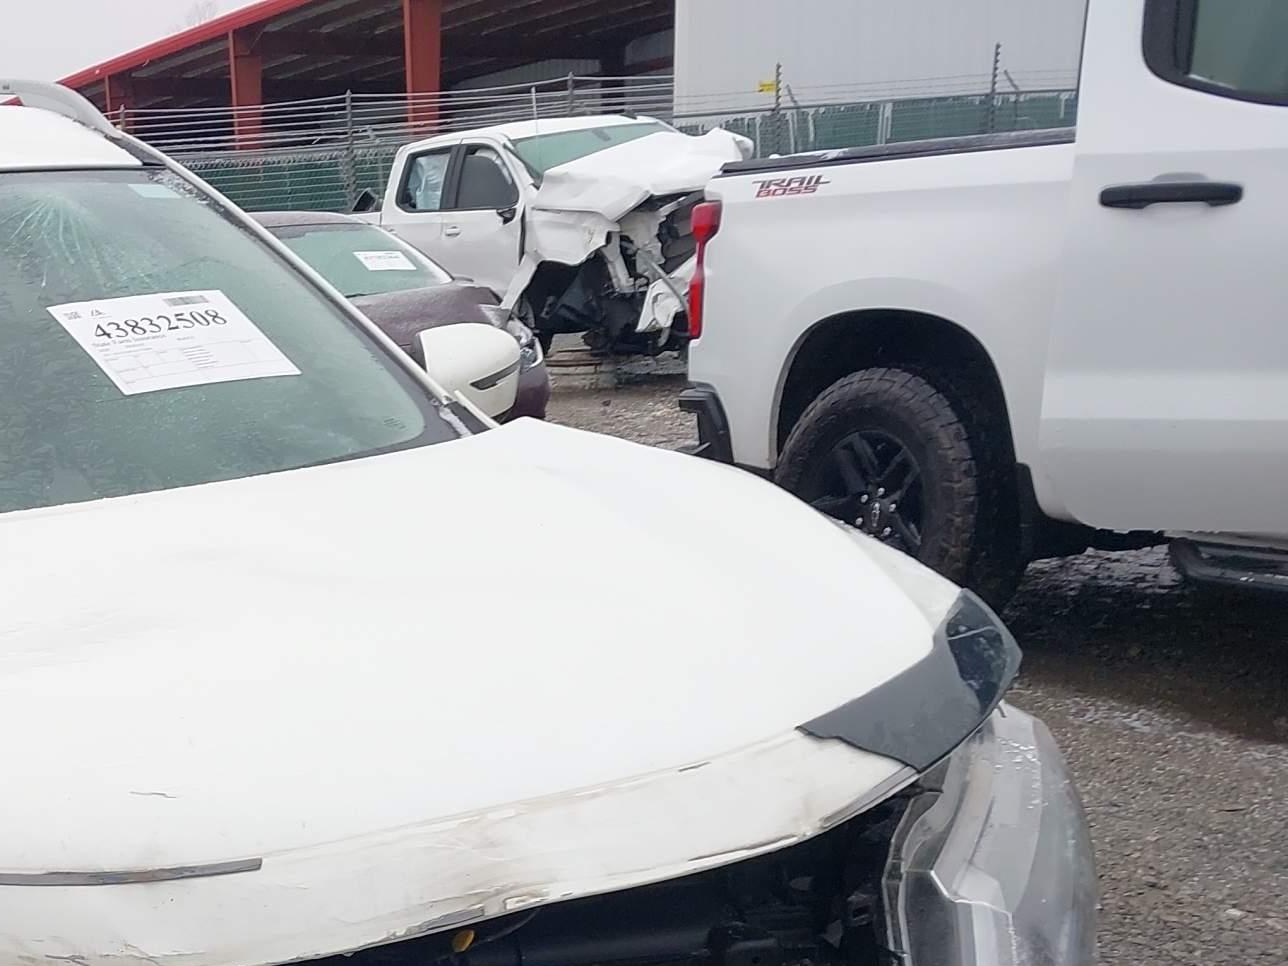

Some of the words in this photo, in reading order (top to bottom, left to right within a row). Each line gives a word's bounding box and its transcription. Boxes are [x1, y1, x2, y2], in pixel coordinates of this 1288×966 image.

[752, 175, 831, 189] TRAIL
[755, 184, 819, 198] BOSS
[94, 309, 227, 339] 43832508
